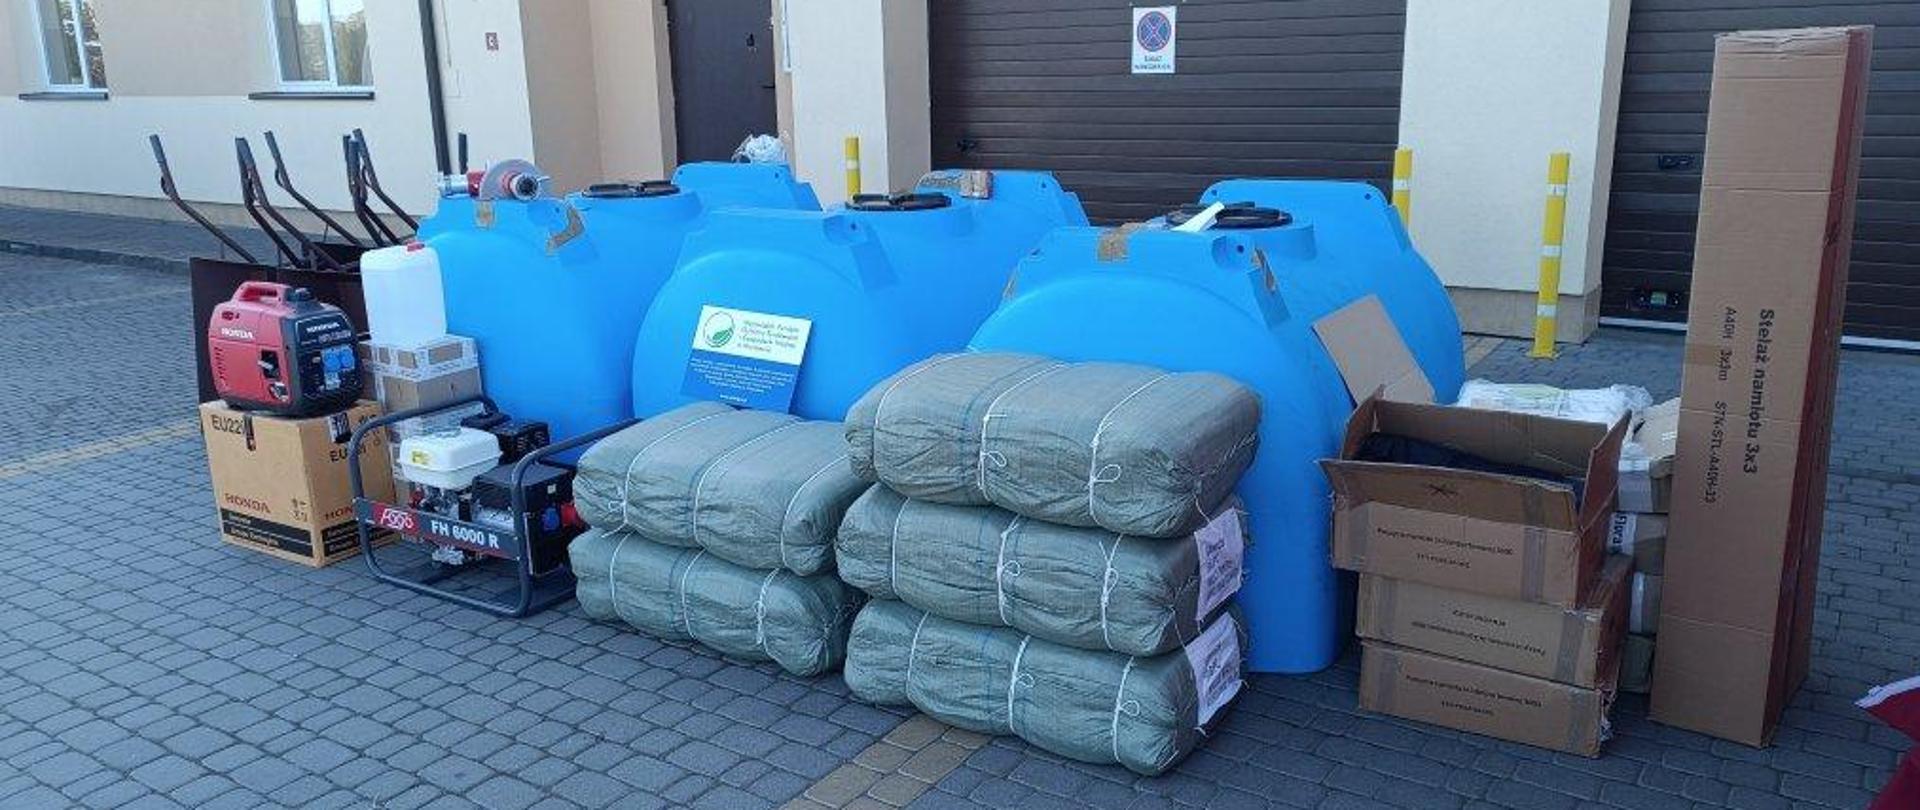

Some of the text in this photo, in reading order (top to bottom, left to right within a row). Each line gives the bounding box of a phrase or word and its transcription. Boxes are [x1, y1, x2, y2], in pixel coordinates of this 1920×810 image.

[221, 327, 253, 339] HONDA
[1743, 443, 1760, 474] 3x3
[224, 493, 271, 513] HONDA
[325, 505, 353, 520] HON
[431, 520, 499, 549] FH 6000 R
